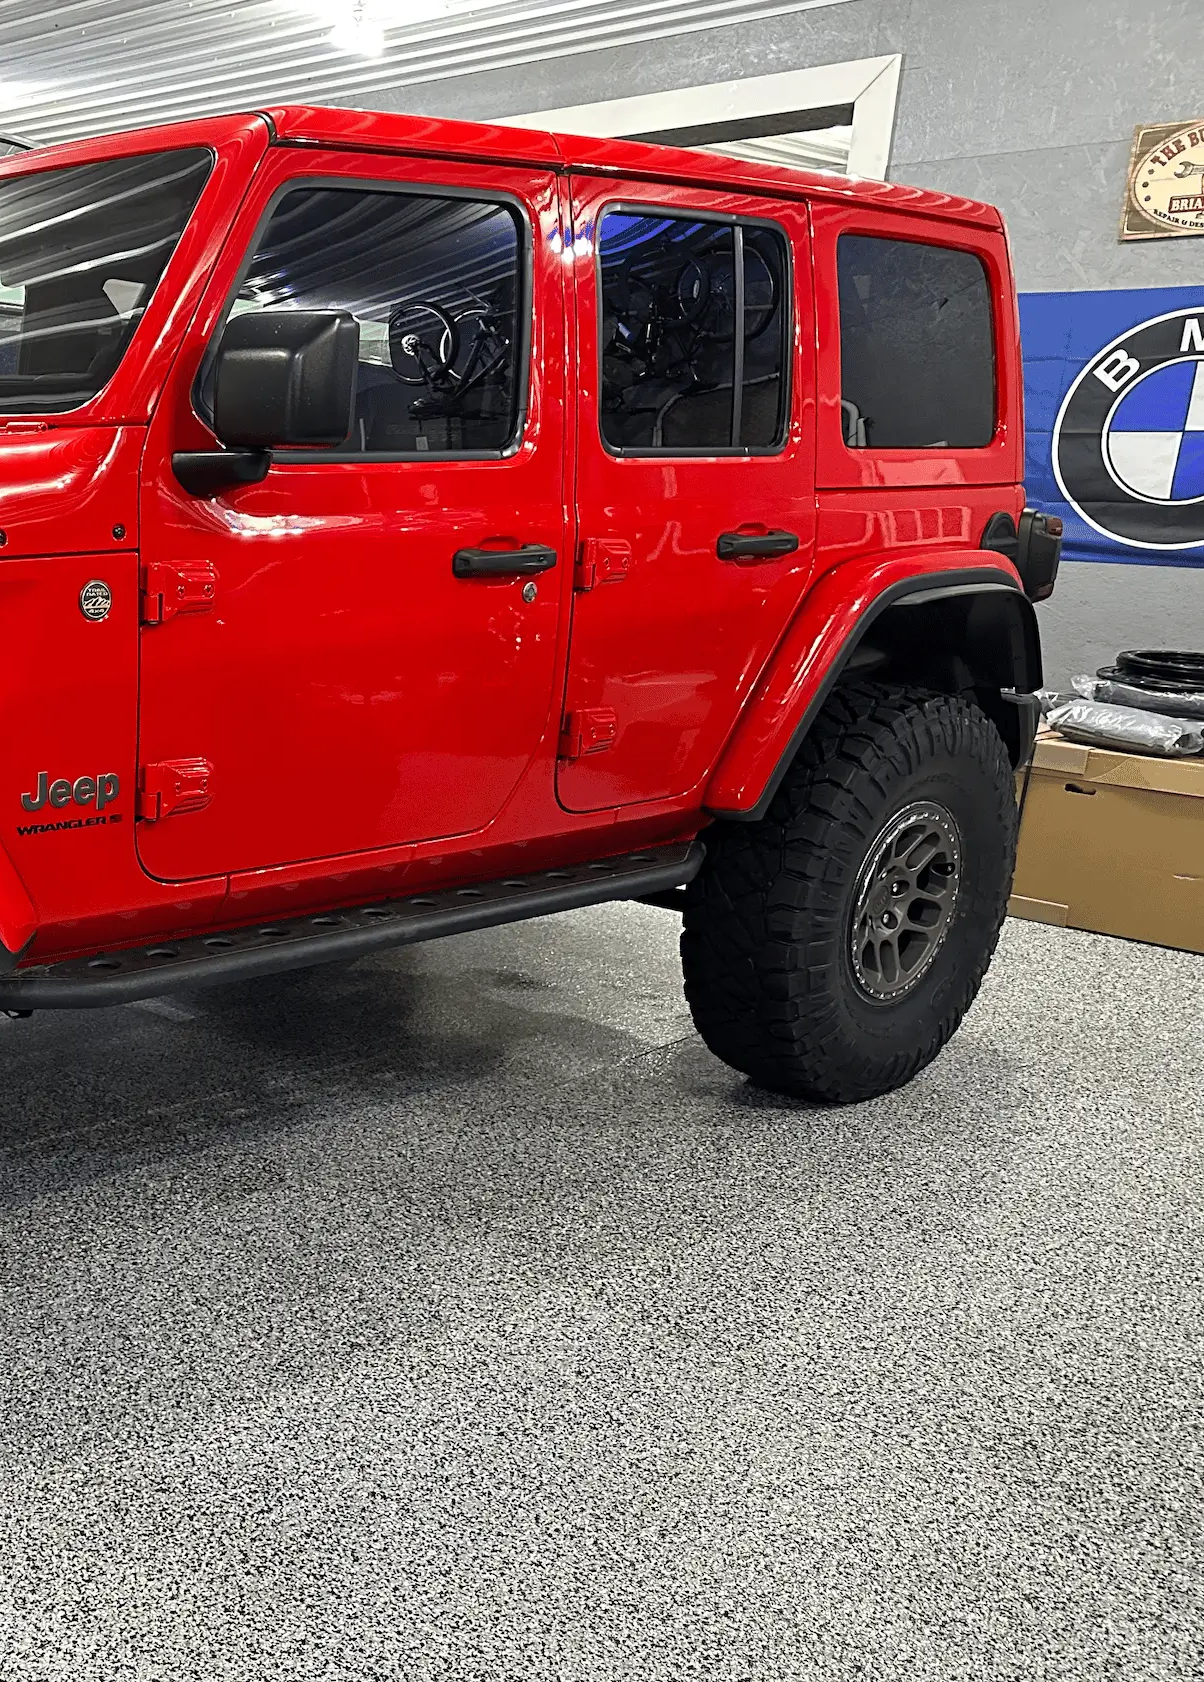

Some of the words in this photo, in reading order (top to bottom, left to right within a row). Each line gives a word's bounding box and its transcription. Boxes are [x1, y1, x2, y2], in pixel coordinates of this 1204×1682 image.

[1150, 138, 1186, 166] THE
[1153, 208, 1180, 224] REPAIR
[20, 771, 120, 811] Jeep
[16, 815, 107, 837] WRANGLER
